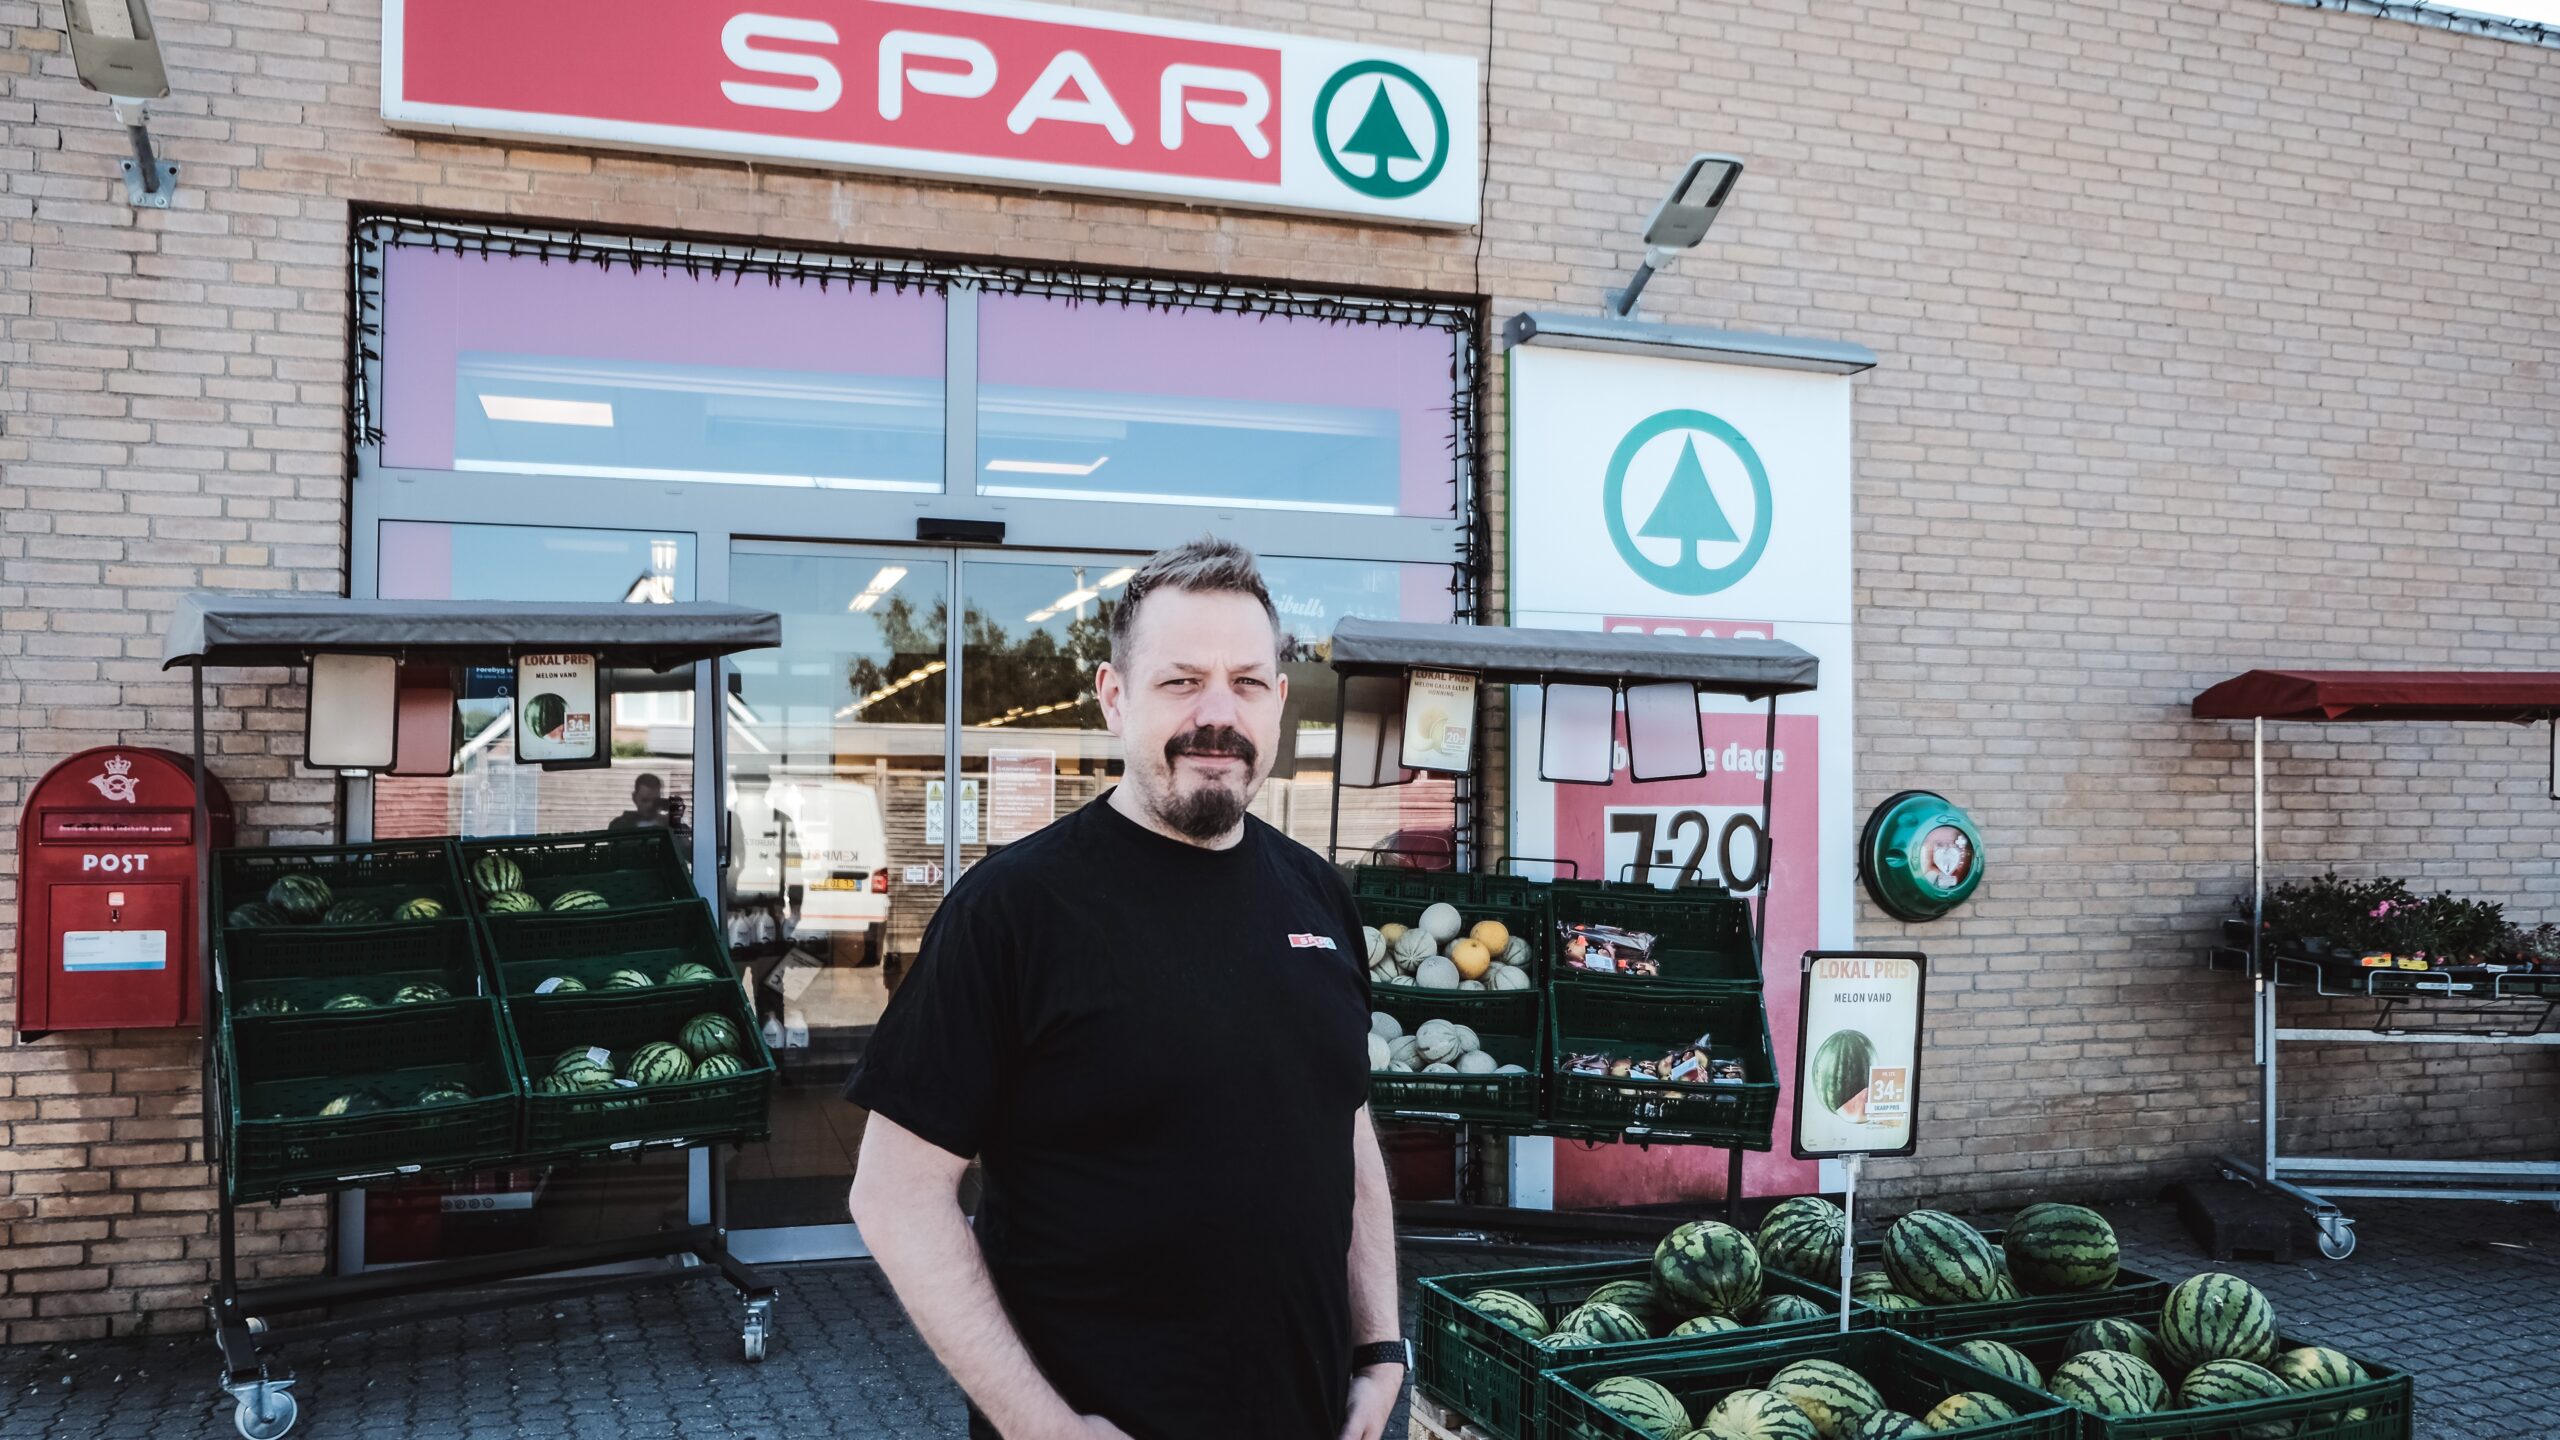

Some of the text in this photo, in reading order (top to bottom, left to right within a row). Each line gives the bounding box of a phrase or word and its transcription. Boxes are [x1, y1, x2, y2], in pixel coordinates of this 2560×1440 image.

[720, 12, 1271, 158] SPAR
[524, 654, 589, 666] LOKAL PRIS
[1722, 742, 1785, 780] dage
[83, 853, 149, 874] POST
[1818, 960, 1910, 980] LOKAL PRIS
[1834, 992, 1892, 1003] MELON VAND
